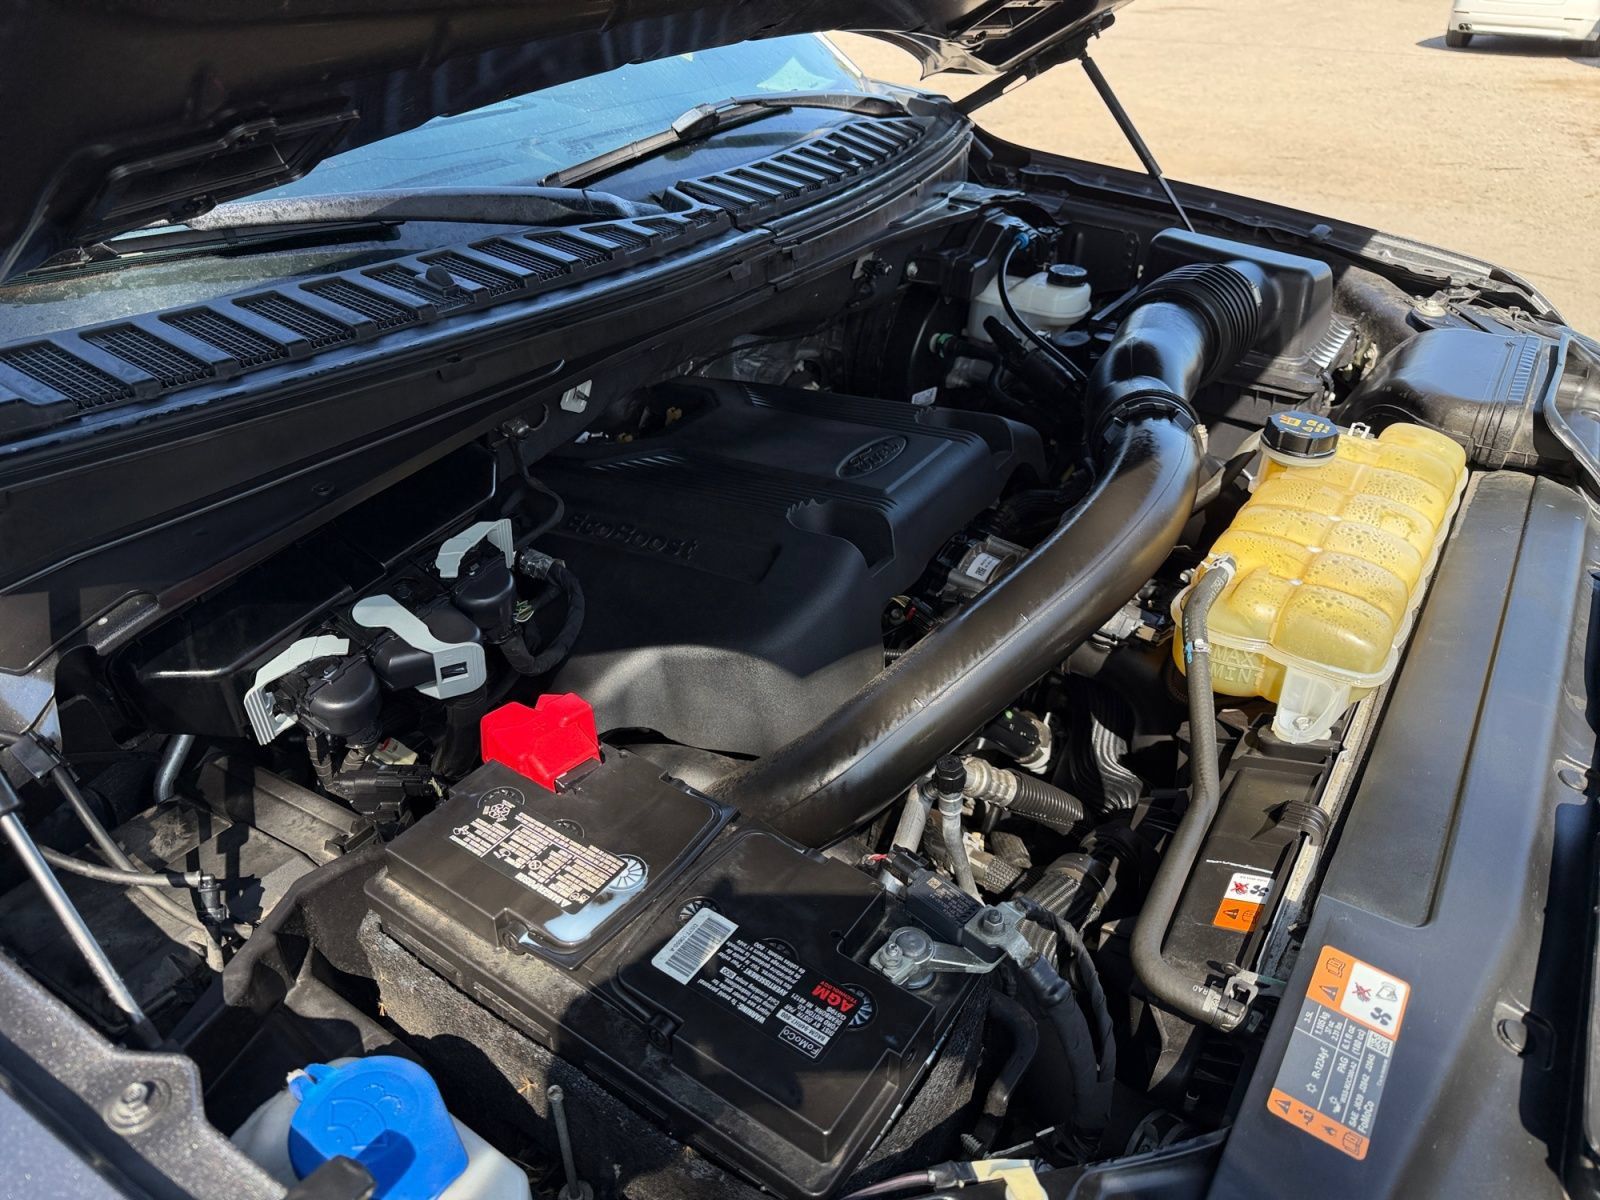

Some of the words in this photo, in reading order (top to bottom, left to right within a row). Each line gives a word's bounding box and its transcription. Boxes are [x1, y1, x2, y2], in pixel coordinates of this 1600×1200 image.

[1212, 646, 1256, 668] MAX
[1211, 663, 1252, 683] MIN
[730, 950, 747, 962] guide
[695, 976, 721, 993] personal
[716, 981, 735, 994] guide
[741, 966, 789, 997] AVERTISSEMENT
[781, 981, 793, 990] des
[1192, 984, 1209, 996] RAD
[715, 989, 733, 1001] avoid
[745, 982, 770, 999] cranking
[810, 983, 854, 1014] AGM
[818, 979, 858, 1005] TECHNOLOGY
[728, 997, 738, 1005] To
[765, 994, 781, 1006] Cold
[783, 1002, 797, 1013] PAR
[804, 1000, 814, 1009] MI
[734, 1001, 767, 1024] WARNING:
[803, 1007, 825, 1023] MOTOR
[811, 1005, 843, 1026] DEARBORN,
[1319, 1009, 1331, 1021] kg
[811, 1019, 822, 1028] BY
[821, 1018, 839, 1032] FORD
[780, 1027, 820, 1056] FoMoCo
[1309, 1045, 1331, 1080] R-1234yf
[1335, 1054, 1349, 1074] PAG
[1347, 1109, 1360, 1128] SAE
[1355, 1098, 1376, 1134] FoMoCo
